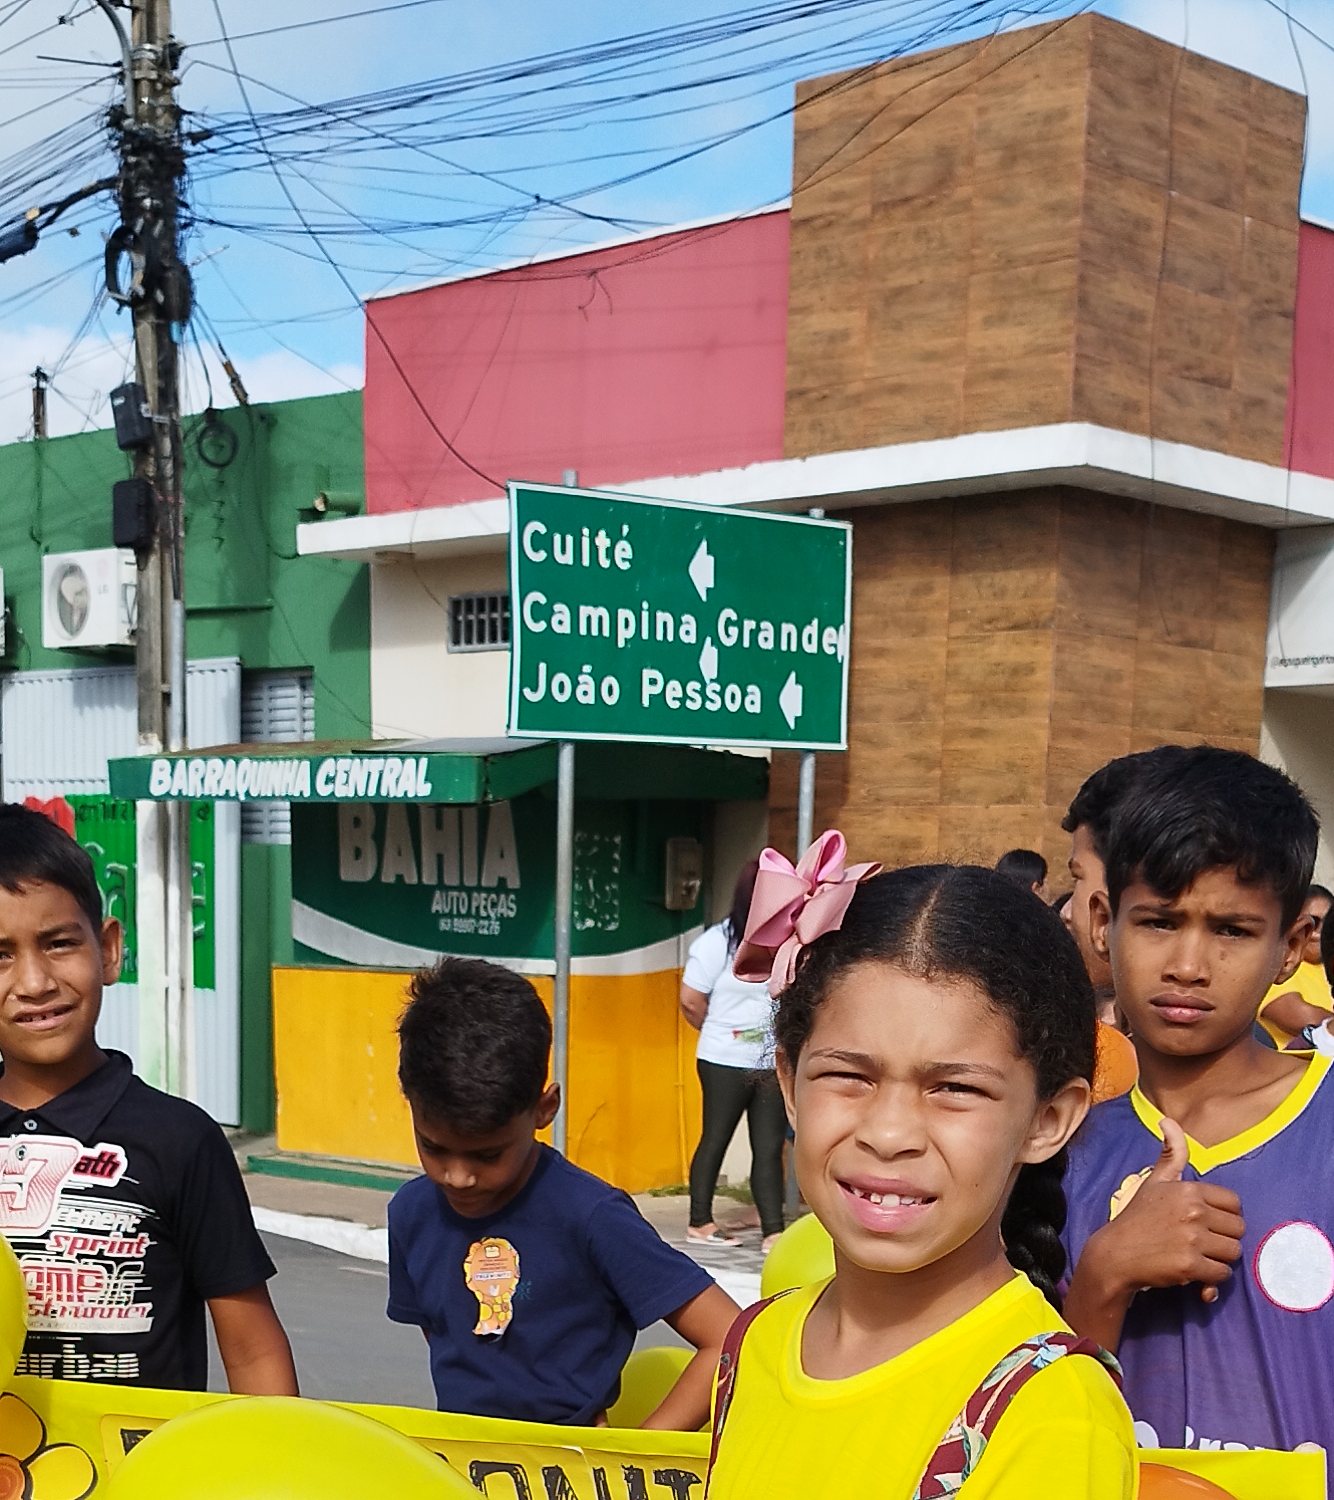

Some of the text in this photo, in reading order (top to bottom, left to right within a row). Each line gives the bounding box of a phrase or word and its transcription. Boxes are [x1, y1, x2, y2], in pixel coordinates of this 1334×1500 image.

[522, 520, 634, 571] Cuité
[522, 590, 840, 657] Campina Grande
[522, 661, 762, 714] João Pessoa
[149, 756, 433, 800] BARRAQUINHA CENTRAL
[338, 799, 522, 889] BAHIA
[431, 890, 517, 921] AUTO PEÇAS
[49, 1232, 147, 1256] sprint
